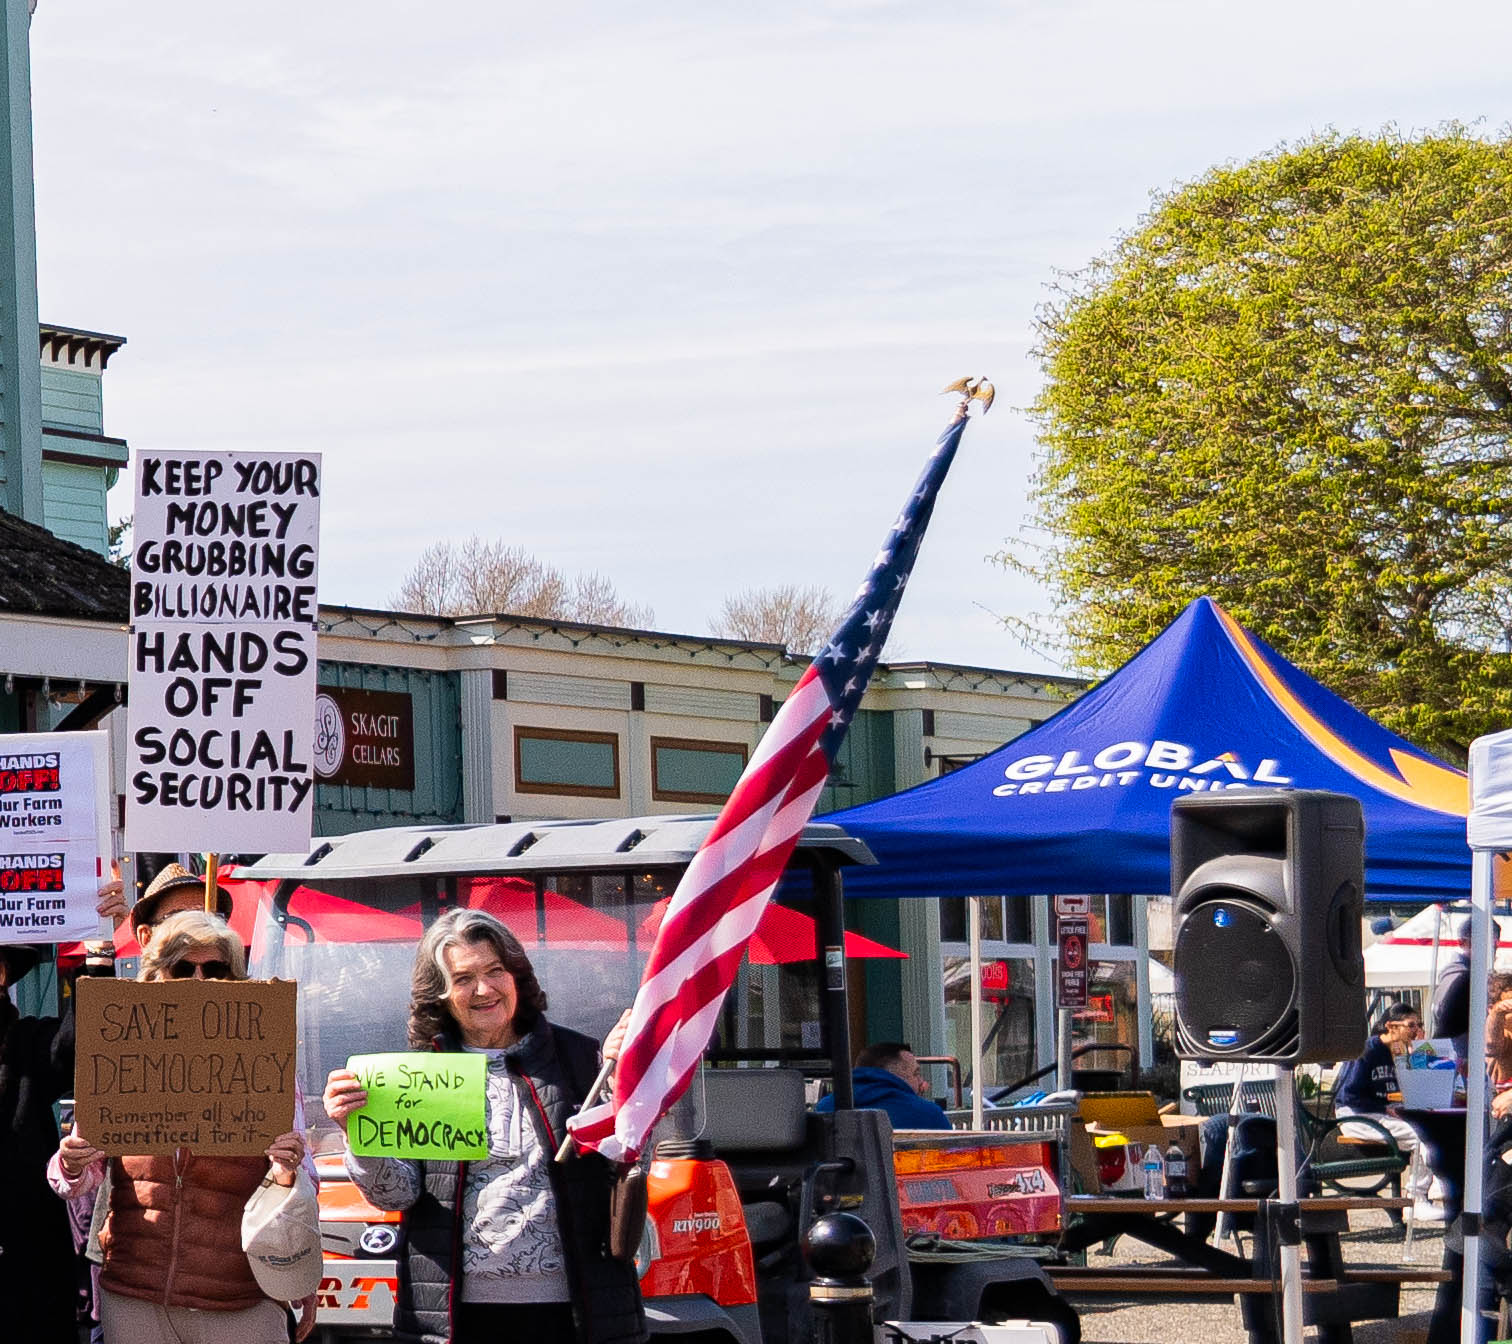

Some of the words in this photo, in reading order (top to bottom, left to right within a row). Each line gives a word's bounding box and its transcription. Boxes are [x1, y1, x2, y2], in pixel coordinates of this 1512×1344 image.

[142, 458, 222, 497] KEEP
[234, 460, 319, 497] YOUR
[166, 500, 298, 539] MONEY
[137, 540, 315, 579] GRUBBING
[134, 581, 316, 622] BILLIONAIRE
[136, 631, 308, 676] HANDS
[165, 677, 262, 717] OFF
[352, 713, 399, 738] SKAGIT
[135, 726, 307, 773] SOCIAL
[352, 745, 400, 766] CELLARS
[1004, 740, 1291, 784] GLOBAL
[133, 771, 312, 813] SECURITY
[992, 771, 1138, 797] CREDIT
[1150, 773, 1250, 791] UNI
[24, 797, 62, 811] Farm
[0, 855, 61, 869] HANDS
[0, 870, 63, 891] OFF!
[27, 897, 65, 910] Farm
[0, 913, 65, 927] Workers
[100, 1002, 179, 1042] SAVE
[201, 1001, 265, 1041] OUR
[89, 1052, 293, 1096] DEMOCRACY
[398, 1064, 464, 1091] STAND
[99, 1106, 192, 1124] Remember
[202, 1102, 222, 1122] all
[231, 1100, 266, 1123] who
[395, 1093, 422, 1109] for
[101, 1124, 200, 1145] sacrificed
[210, 1123, 236, 1144] for
[358, 1115, 485, 1151] DEMOCRACY
